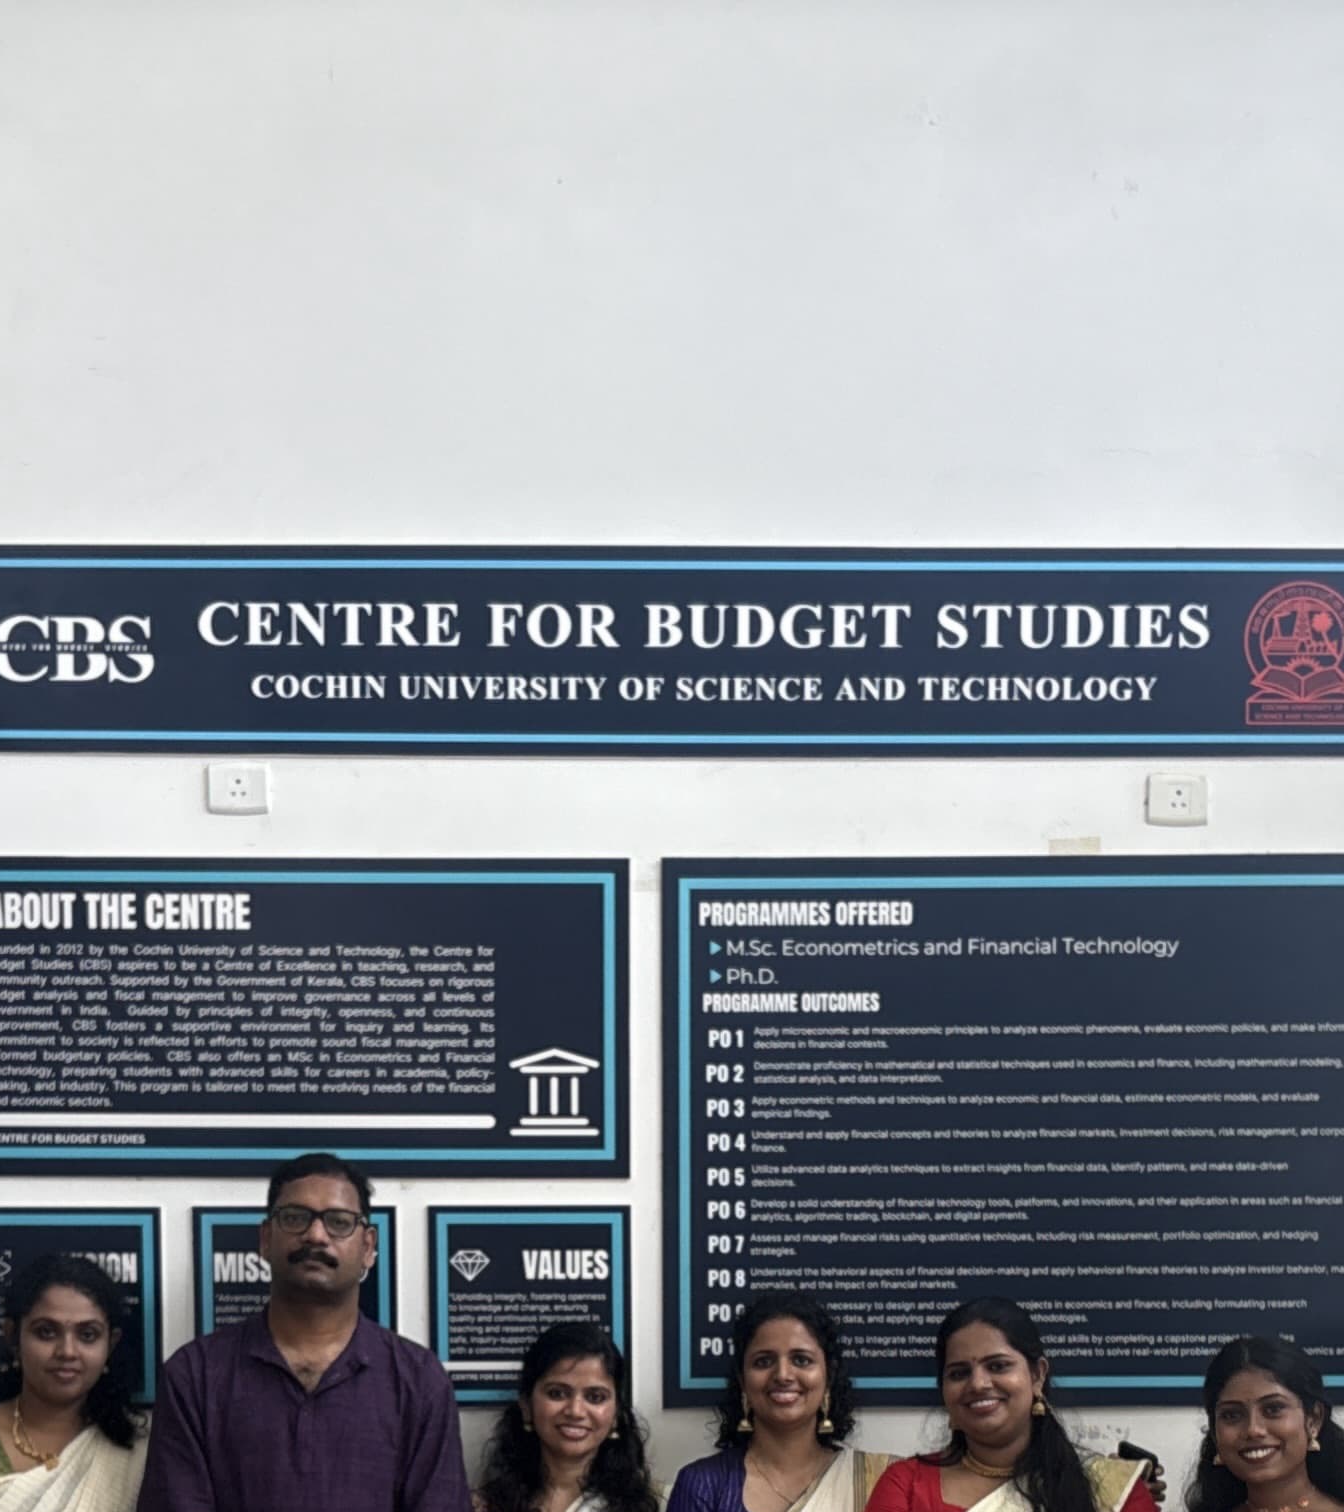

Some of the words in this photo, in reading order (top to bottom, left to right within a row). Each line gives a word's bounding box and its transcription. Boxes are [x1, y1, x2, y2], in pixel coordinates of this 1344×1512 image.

[198, 602, 460, 646] CENTRE
[488, 603, 618, 647] FOR
[645, 604, 910, 648] BUDGET
[937, 603, 1209, 649] STUDIES
[251, 675, 385, 698] COCHIN
[400, 675, 606, 699] UNIVERSITY
[619, 677, 664, 700] OF
[676, 677, 822, 701] SCIENCE
[835, 677, 905, 700] AND
[917, 676, 1156, 701] TECHNOLOGY
[83, 892, 136, 929] THE
[145, 893, 250, 930] CENTRE
[699, 901, 830, 926] PROGRAMMES
[835, 901, 912, 925] OFFERED
[40, 944, 50, 953] in
[56, 944, 83, 954] 2012
[88, 944, 103, 956] by
[108, 944, 128, 954] the
[133, 944, 173, 954] Cochin
[178, 945, 235, 957] University
[240, 945, 253, 955] of
[258, 945, 303, 955] Science
[308, 946, 330, 955] and
[409, 946, 428, 956] the
[433, 946, 472, 956] Centre
[477, 945, 494, 956] for
[726, 939, 776, 956] M.Sc.
[781, 939, 919, 955] Econometrics
[923, 938, 962, 955] and
[967, 937, 1057, 954] Financial
[1061, 936, 1179, 957] Technology
[31, 959, 73, 969] Studies
[79, 959, 111, 970] (CBS)
[117, 960, 158, 971] aspires
[163, 960, 176, 970] to
[181, 960, 196, 970] be
[202, 962, 209, 970] a
[214, 960, 253, 970] Centre
[258, 960, 271, 970] of
[276, 960, 336, 971] Excellence
[341, 961, 352, 970] in
[472, 961, 494, 971] and
[110, 974, 169, 986] Supported
[173, 975, 188, 987] by
[193, 975, 212, 985] the
[216, 975, 285, 985] Government
[290, 975, 303, 985] of
[350, 975, 375, 986] CBS
[379, 976, 424, 986] focuses
[428, 978, 444, 986] on
[447, 976, 494, 989] rigorous
[726, 967, 778, 984] Ph.D.
[32, 990, 78, 1001] analysis
[85, 990, 107, 1000] and
[114, 990, 144, 1000] fiscal
[151, 991, 224, 1003] management
[232, 991, 244, 1001] to
[251, 990, 297, 1002] improve
[304, 993, 371, 1003] governance
[377, 993, 415, 1001] across
[422, 992, 436, 1001] all
[442, 992, 475, 1001] levels
[482, 991, 494, 1001] of
[702, 993, 797, 1012] PROGRAMME
[801, 992, 879, 1012] OUTCOMES
[708, 1029, 731, 1048] PO
[735, 1029, 743, 1047] 1
[753, 1026, 779, 1036] Apply
[851, 1026, 870, 1034] and
[871, 1026, 942, 1034] macroeconomic
[944, 1025, 988, 1035] principles
[1002, 1025, 1038, 1035] analyze
[1039, 1025, 1083, 1033] economic
[1143, 1024, 1183, 1032] evaluate
[1184, 1024, 1228, 1032] economic
[1270, 1023, 1288, 1031] and
[1289, 1023, 1316, 1031] make
[753, 1040, 796, 1048] decisions
[797, 1040, 806, 1048] in
[807, 1039, 845, 1048] financial
[706, 1064, 728, 1082] PO
[733, 1064, 744, 1082] 2
[706, 1098, 729, 1117] PO
[733, 1098, 744, 1117] 3
[31, 1133, 53, 1143] FOR
[54, 1133, 99, 1143] BUDGET
[99, 1134, 145, 1143] STUDIES
[707, 1133, 730, 1151] PO
[734, 1133, 745, 1151] 4
[707, 1167, 730, 1186] PO
[734, 1167, 744, 1186] 5
[707, 1200, 730, 1219] PO
[734, 1201, 745, 1219] 6
[708, 1235, 730, 1253] PO
[735, 1235, 744, 1252] 7
[522, 1249, 608, 1279] VALUES
[750, 1268, 802, 1276] Understand
[820, 1267, 867, 1275] behavioral
[869, 1268, 904, 1276] aspects
[905, 1266, 915, 1275] of
[917, 1266, 955, 1275] financial
[956, 1266, 1030, 1277] decision-making
[1031, 1266, 1048, 1274] and
[1050, 1266, 1075, 1276] apply
[1077, 1266, 1124, 1274] behavioral
[1125, 1265, 1159, 1274] finance
[1160, 1265, 1198, 1274] theories
[1199, 1266, 1210, 1274] to
[1211, 1265, 1246, 1275] analyze
[1247, 1265, 1284, 1273] investor
[708, 1269, 730, 1287] PO
[735, 1269, 745, 1287] 8
[799, 1281, 816, 1289] and
[817, 1281, 833, 1289] the
[834, 1280, 865, 1289] impact
[880, 1279, 917, 1288] financial
[708, 1303, 731, 1323] PO
[700, 1336, 723, 1356] PO
